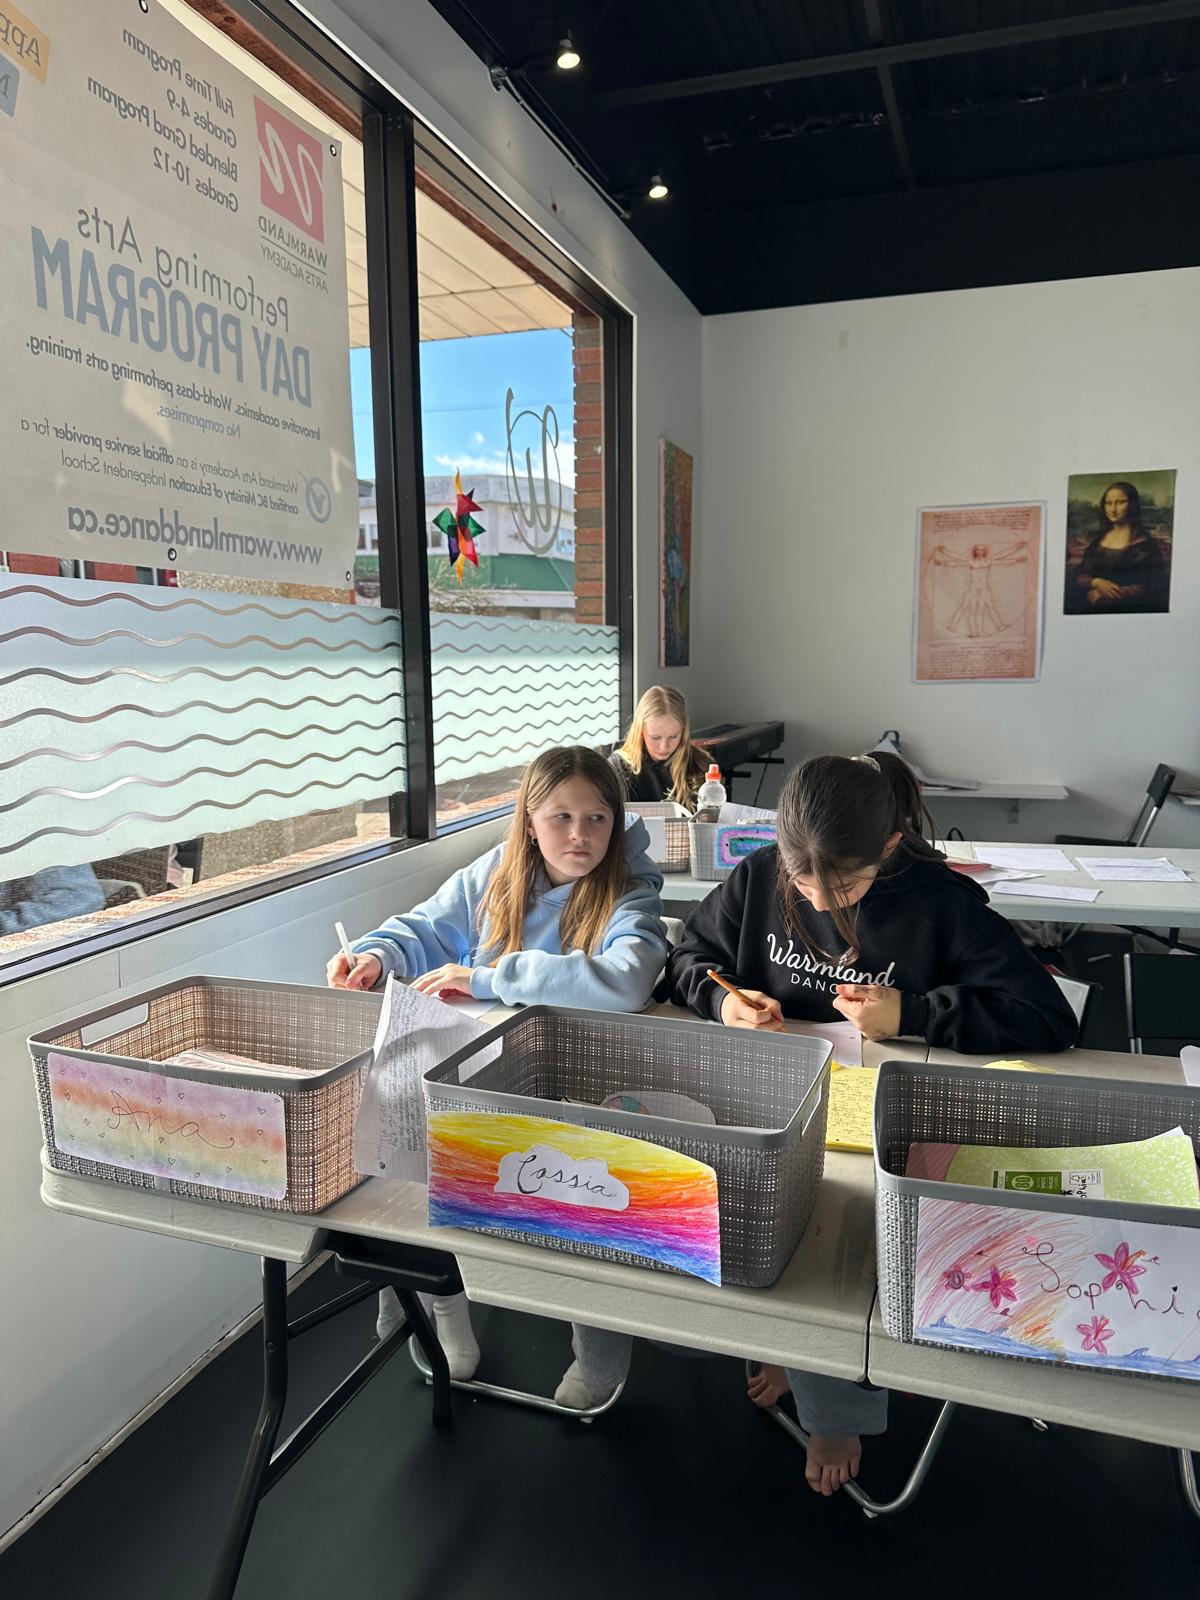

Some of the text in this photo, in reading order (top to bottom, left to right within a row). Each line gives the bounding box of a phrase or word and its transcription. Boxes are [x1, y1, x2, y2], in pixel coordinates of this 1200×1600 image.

[767, 933, 896, 987] Warmland
[790, 973, 838, 995] DANC
[107, 1090, 235, 1149] Ana
[517, 1154, 618, 1198] Cassia
[1021, 1242, 1200, 1320] Sophi
